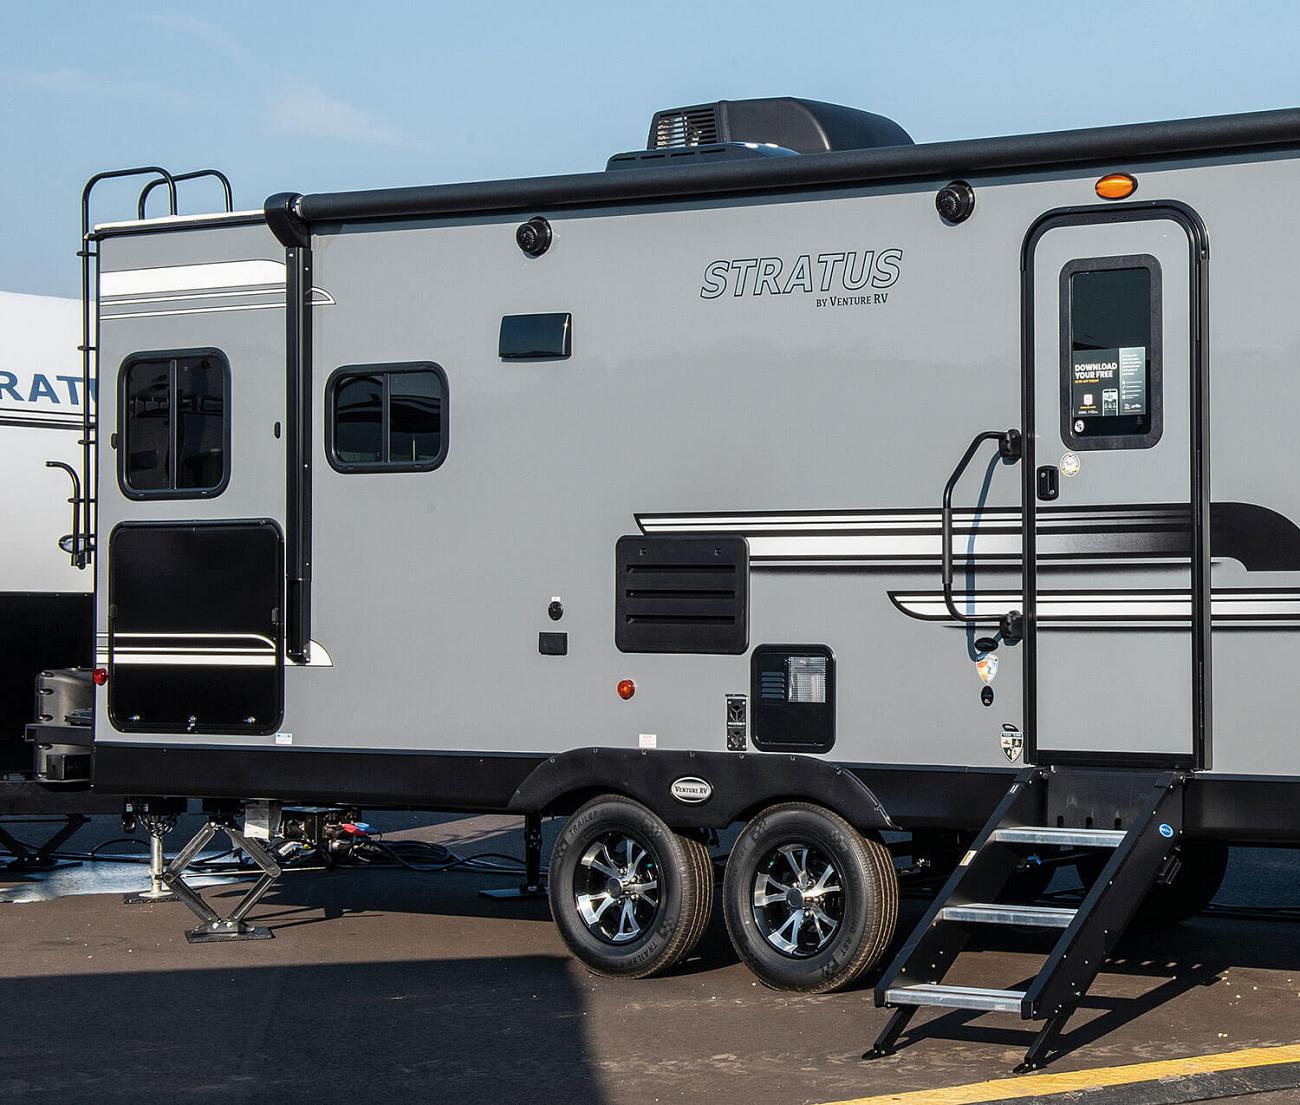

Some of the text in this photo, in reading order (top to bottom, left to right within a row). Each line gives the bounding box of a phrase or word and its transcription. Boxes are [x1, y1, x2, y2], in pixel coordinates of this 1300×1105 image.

[700, 248, 903, 299] STRATUS
[816, 293, 889, 308] BY VENTURE RV
[1074, 362, 1118, 372] DOWNLOAD
[1074, 370, 1114, 379] YOUR FREE
[674, 786, 698, 794] VENTURE
